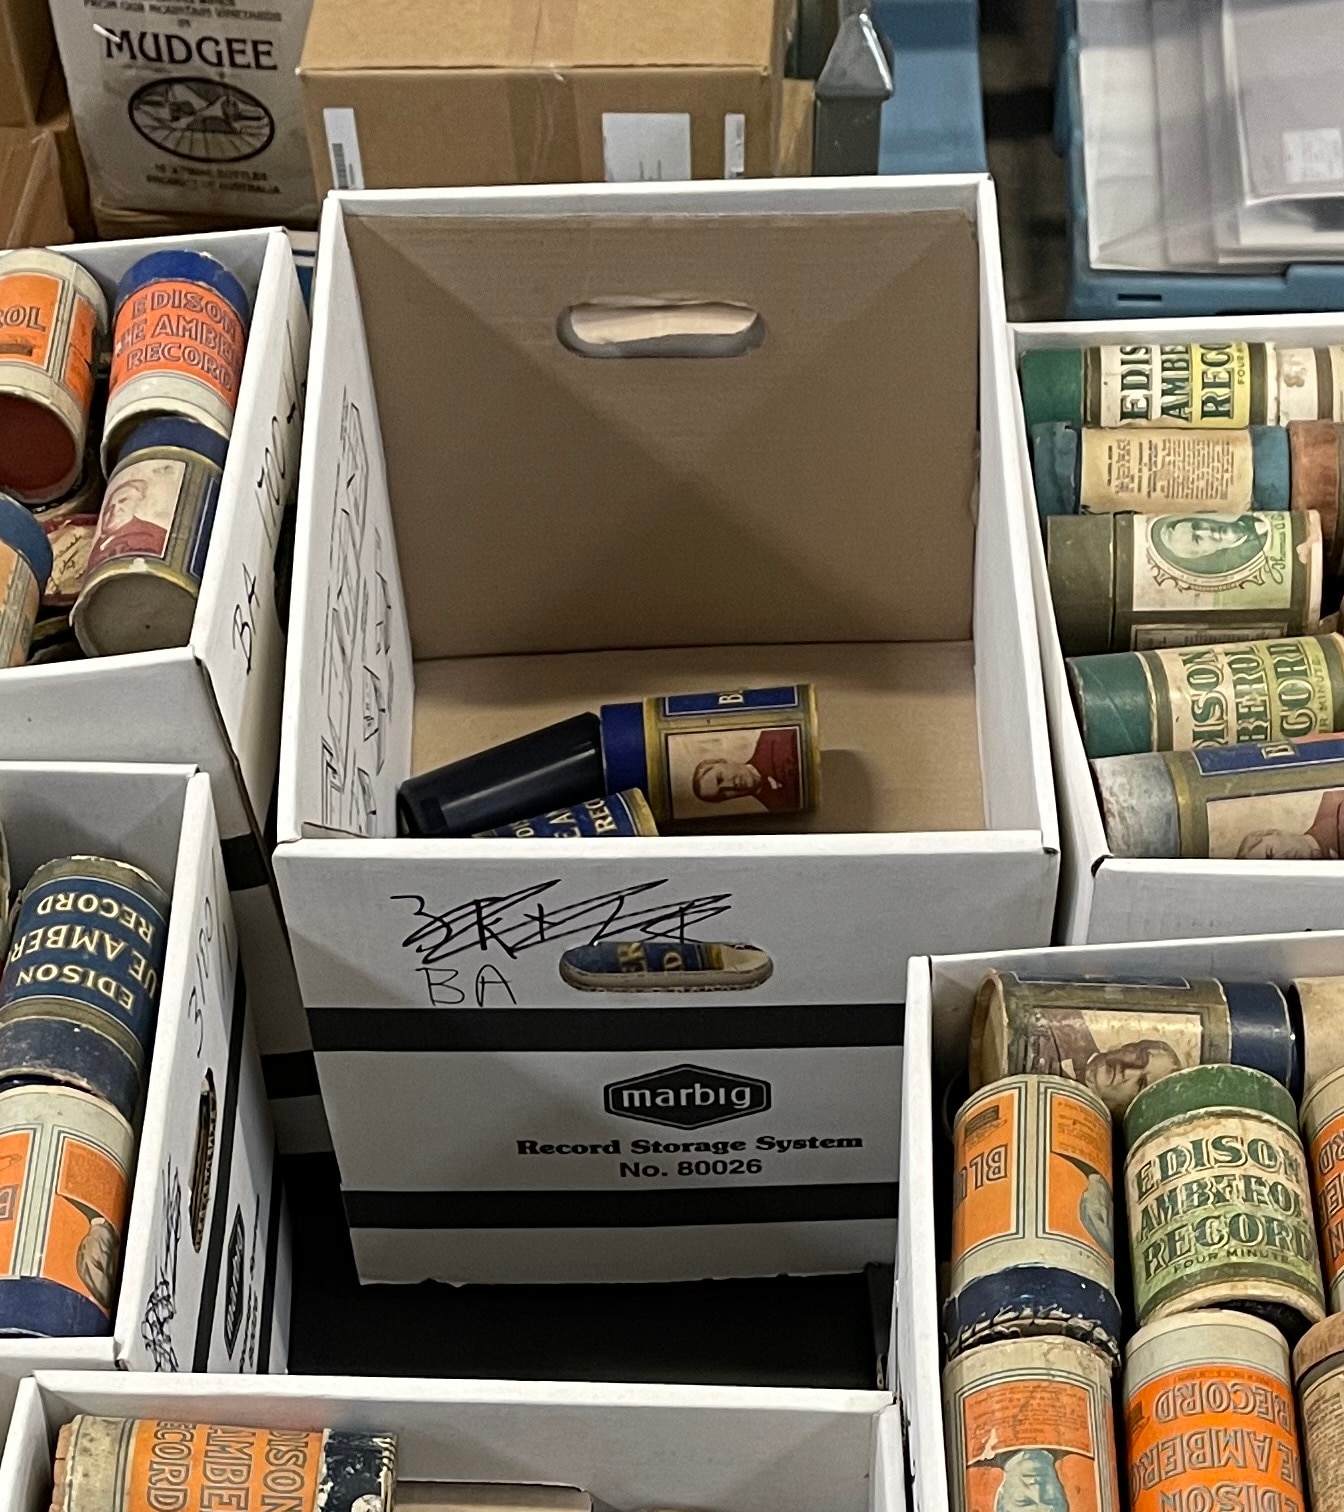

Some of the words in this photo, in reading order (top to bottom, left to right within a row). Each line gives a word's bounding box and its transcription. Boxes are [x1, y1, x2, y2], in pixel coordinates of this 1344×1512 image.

[105, 28, 277, 70] MUDGEE
[133, 289, 235, 342] EDISON
[127, 342, 232, 391] RECORD
[1119, 346, 1153, 422] EDIS
[1200, 343, 1234, 419] REC
[1179, 649, 1228, 748] ISON
[37, 893, 155, 944] RECORD
[15, 963, 136, 1012] EDISON
[419, 962, 519, 1006] BA
[621, 1082, 754, 1111] marbig
[515, 1138, 622, 1156] Record
[629, 1136, 747, 1156] Storage
[755, 1131, 863, 1152] System
[619, 1160, 667, 1177] No.
[676, 1157, 763, 1177] 80026
[1133, 1134, 1304, 1204] EDISON
[1141, 1210, 1314, 1281] RECORD
[1173, 1254, 1220, 1274] FOUR
[1154, 1378, 1296, 1430] RECORD
